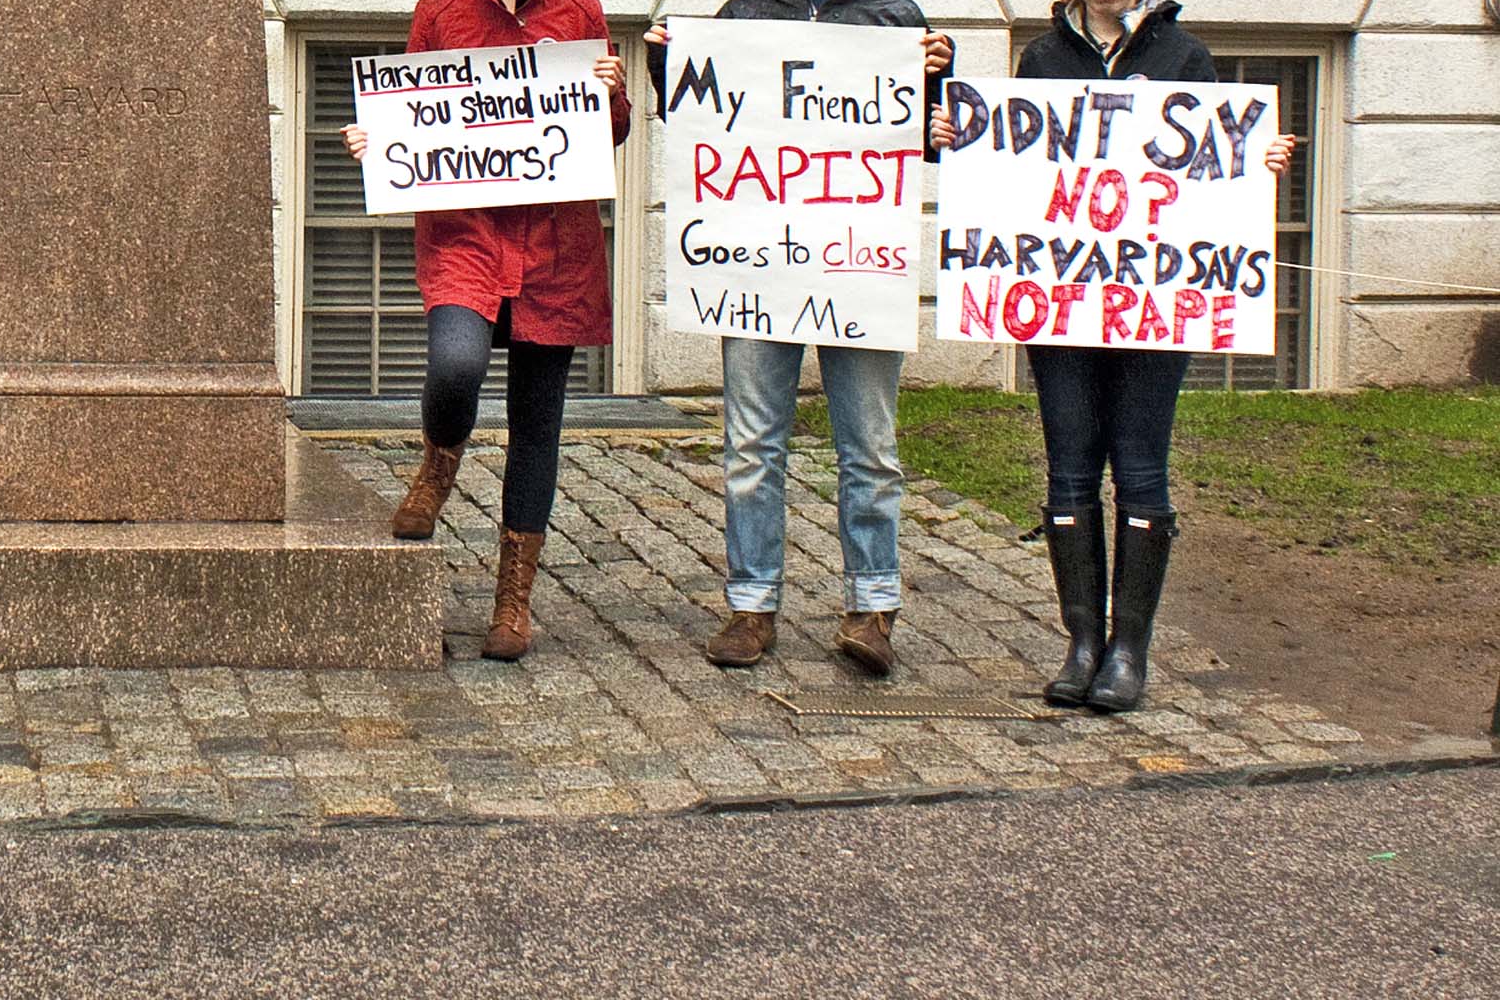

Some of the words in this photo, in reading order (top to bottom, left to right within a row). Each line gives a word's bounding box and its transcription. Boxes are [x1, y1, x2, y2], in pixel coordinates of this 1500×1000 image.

[356, 58, 481, 92] Harvard,
[489, 46, 539, 80] will
[541, 82, 600, 114] with
[668, 56, 746, 132] My
[385, 125, 569, 190] Survivors?
[946, 81, 1135, 164] DIDN'T
[1142, 92, 1268, 181] SAY
[694, 143, 922, 207] RAPIST
[1044, 167, 1179, 242] NO?
[680, 219, 769, 268] Goes
[778, 224, 810, 265] to
[822, 226, 907, 270] class
[940, 228, 1184, 286] HARVARD
[1187, 241, 1270, 298] SAYS
[690, 287, 772, 334] With
[791, 296, 866, 338] Me
[960, 275, 1086, 342] NOT
[1102, 283, 1236, 350] RAPE
